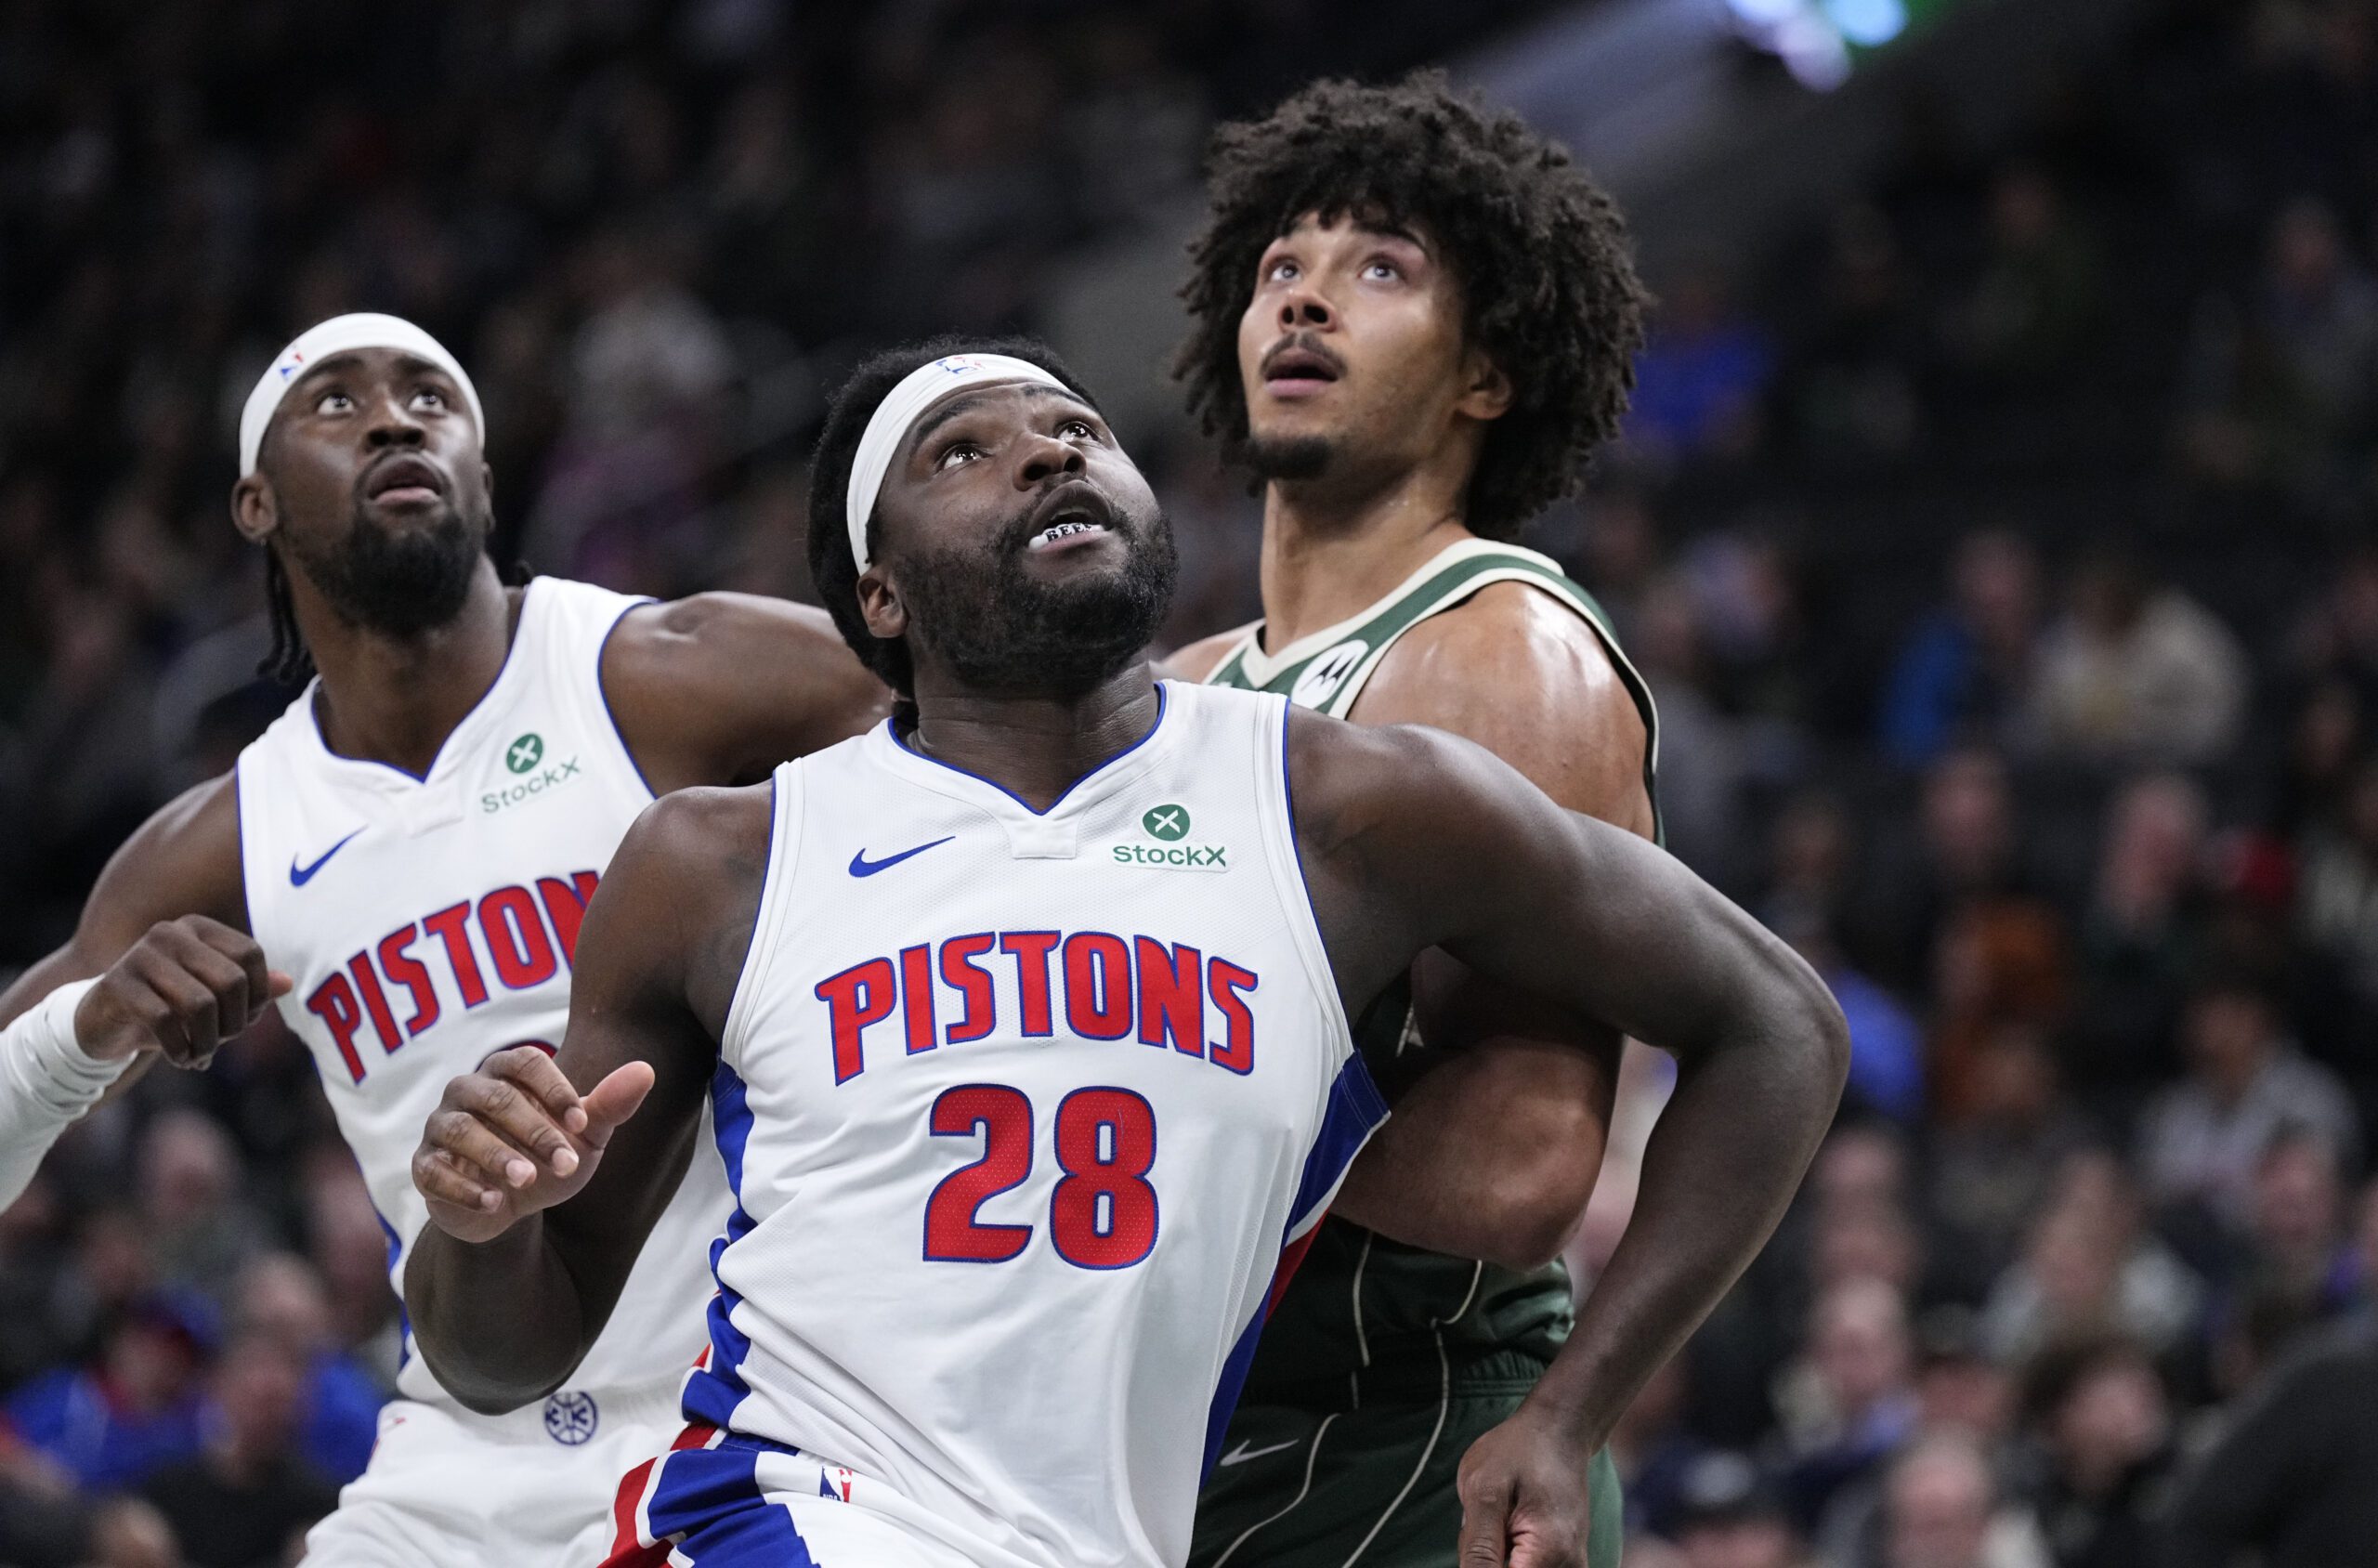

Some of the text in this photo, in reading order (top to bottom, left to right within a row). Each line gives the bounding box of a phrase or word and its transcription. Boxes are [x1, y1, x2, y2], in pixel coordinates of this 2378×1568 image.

[481, 754, 581, 814] StockX
[1113, 844, 1226, 867] StockX
[306, 870, 600, 1085] PISTON
[815, 930, 1258, 1087] PISTONS
[922, 1083, 1159, 1270] 28
